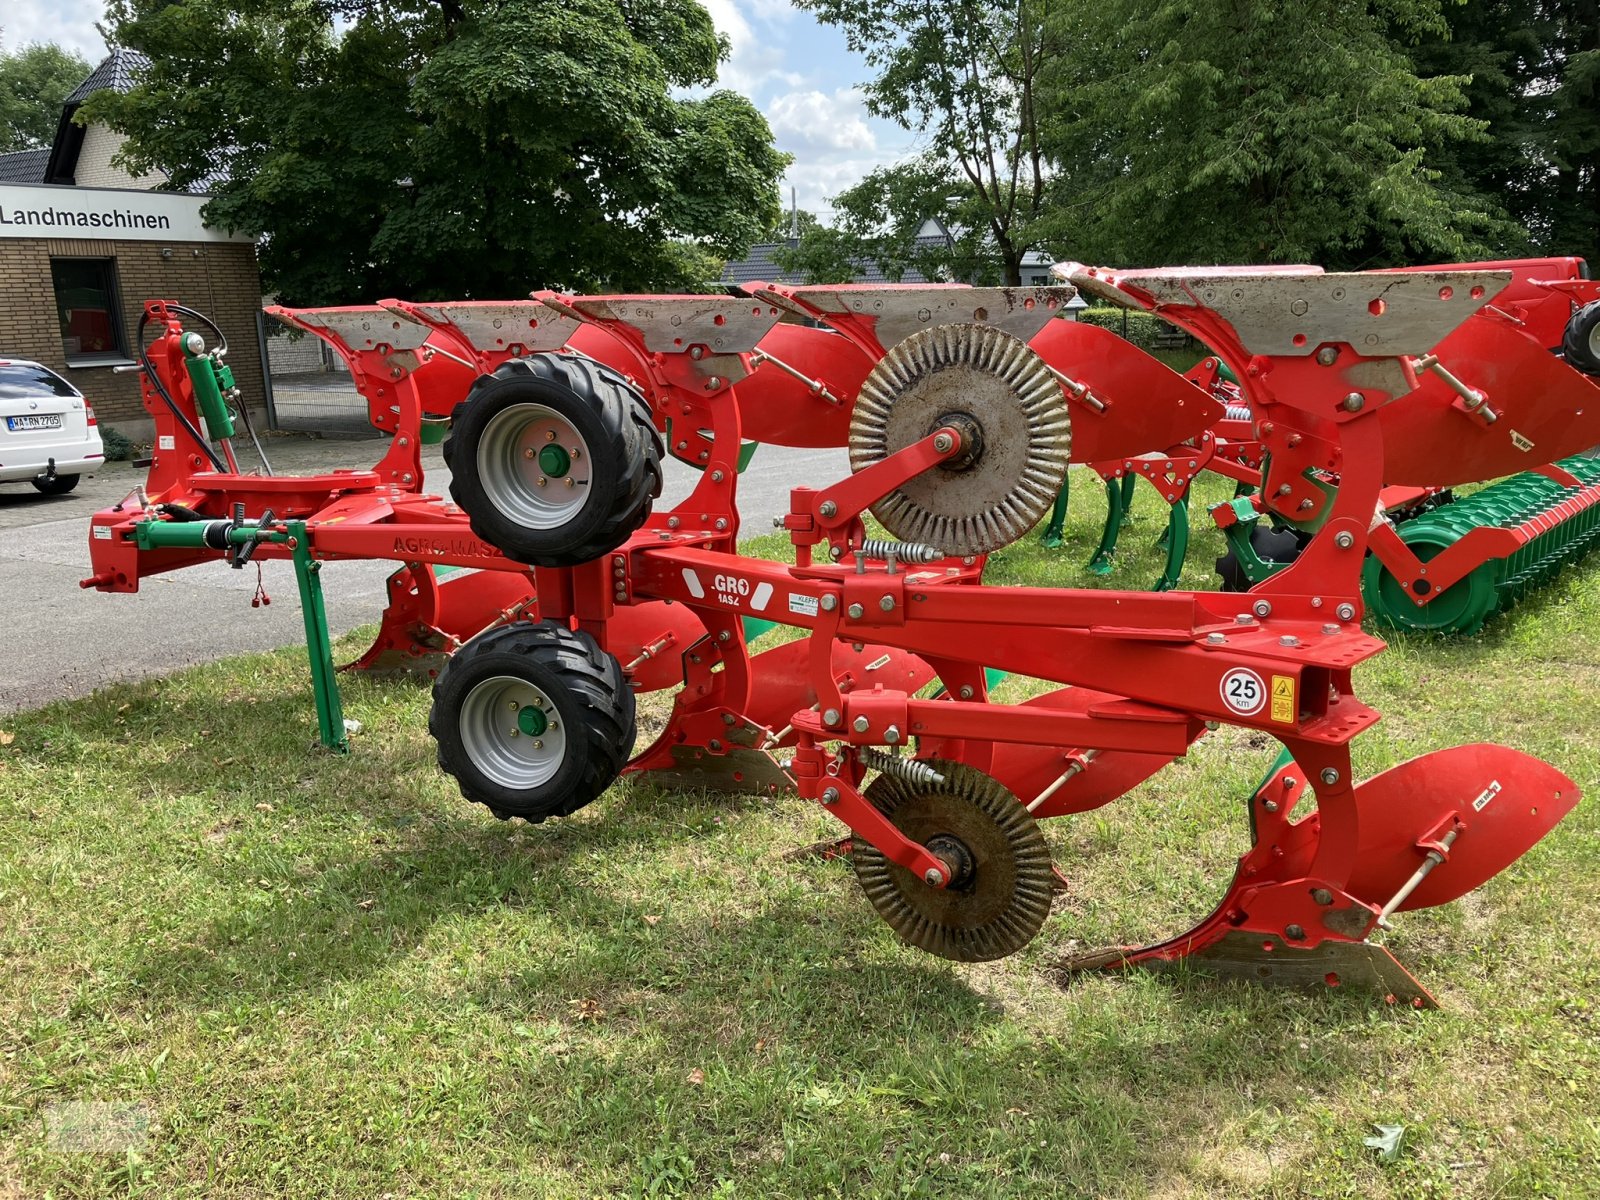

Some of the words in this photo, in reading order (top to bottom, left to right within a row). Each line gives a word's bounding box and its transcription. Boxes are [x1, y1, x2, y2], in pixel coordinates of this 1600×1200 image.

[0, 205, 170, 229] Landmaschinen
[711, 574, 749, 596] GRO
[1230, 678, 1256, 699] 25
[1236, 698, 1250, 708] km
